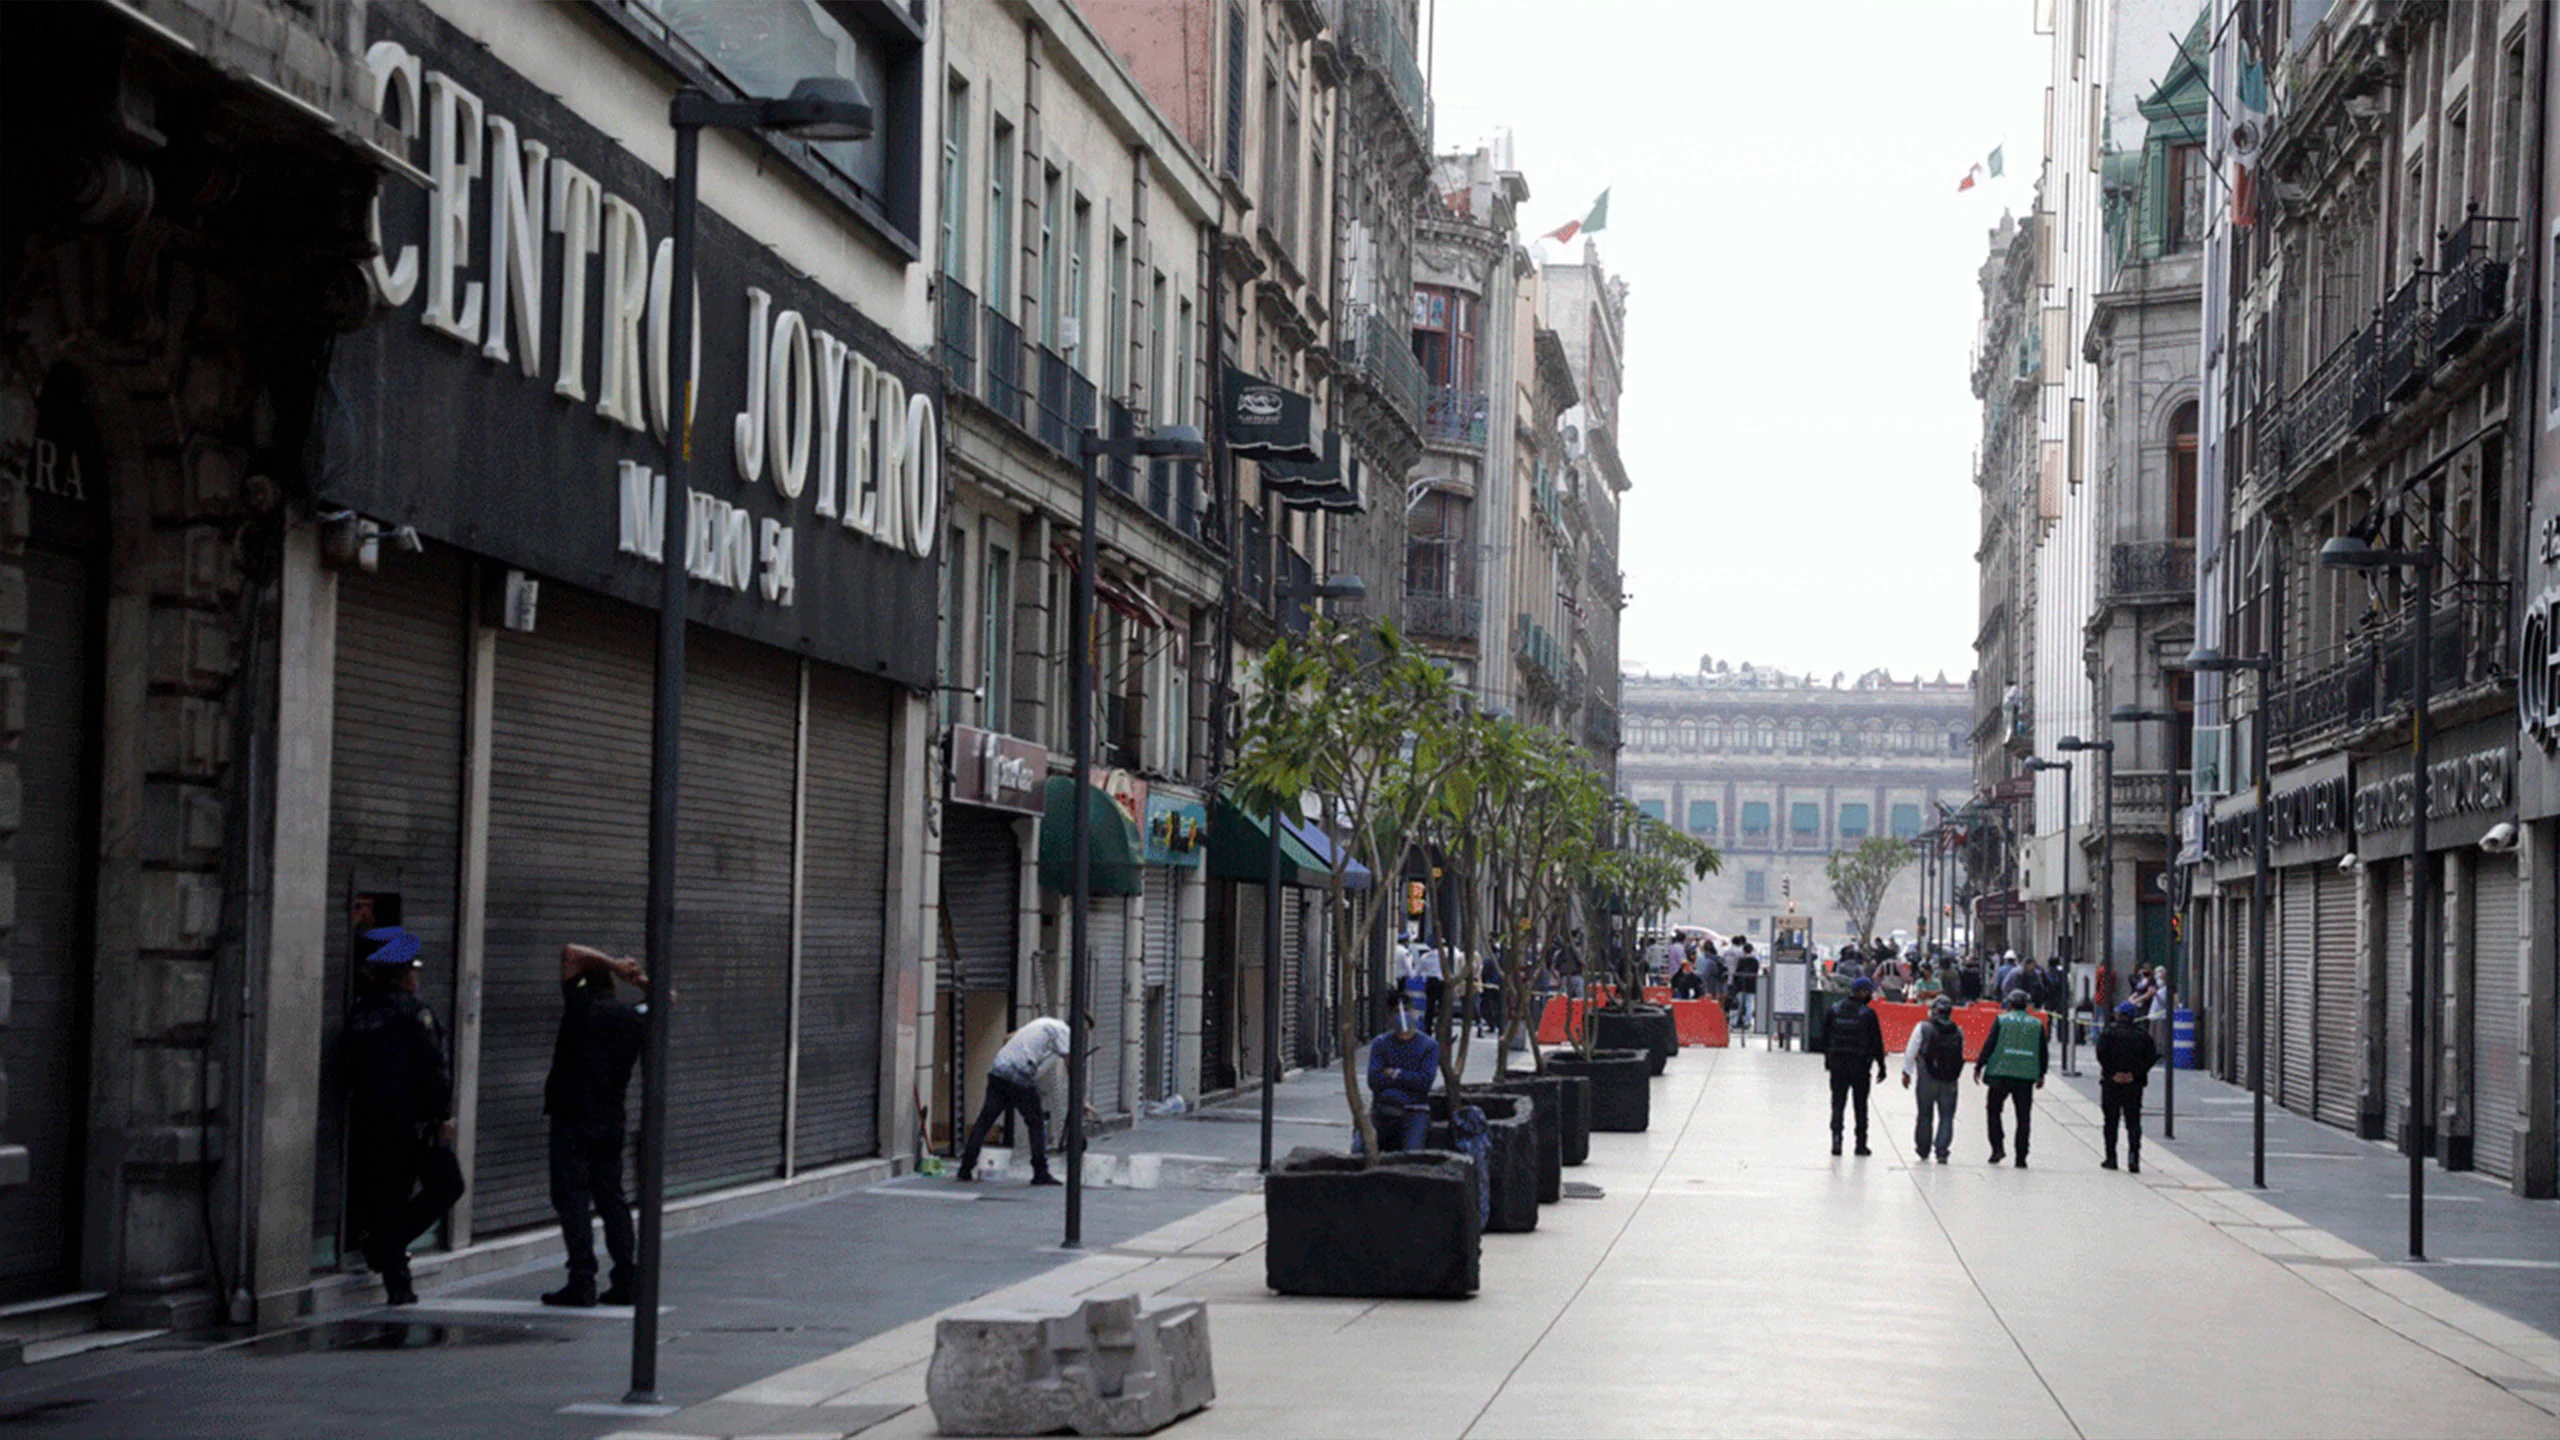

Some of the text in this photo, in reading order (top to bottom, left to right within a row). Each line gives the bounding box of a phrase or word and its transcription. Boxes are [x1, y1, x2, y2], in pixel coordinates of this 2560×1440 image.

[363, 41, 938, 558] CENTRO JOYERO
[760, 517, 794, 606] 54
